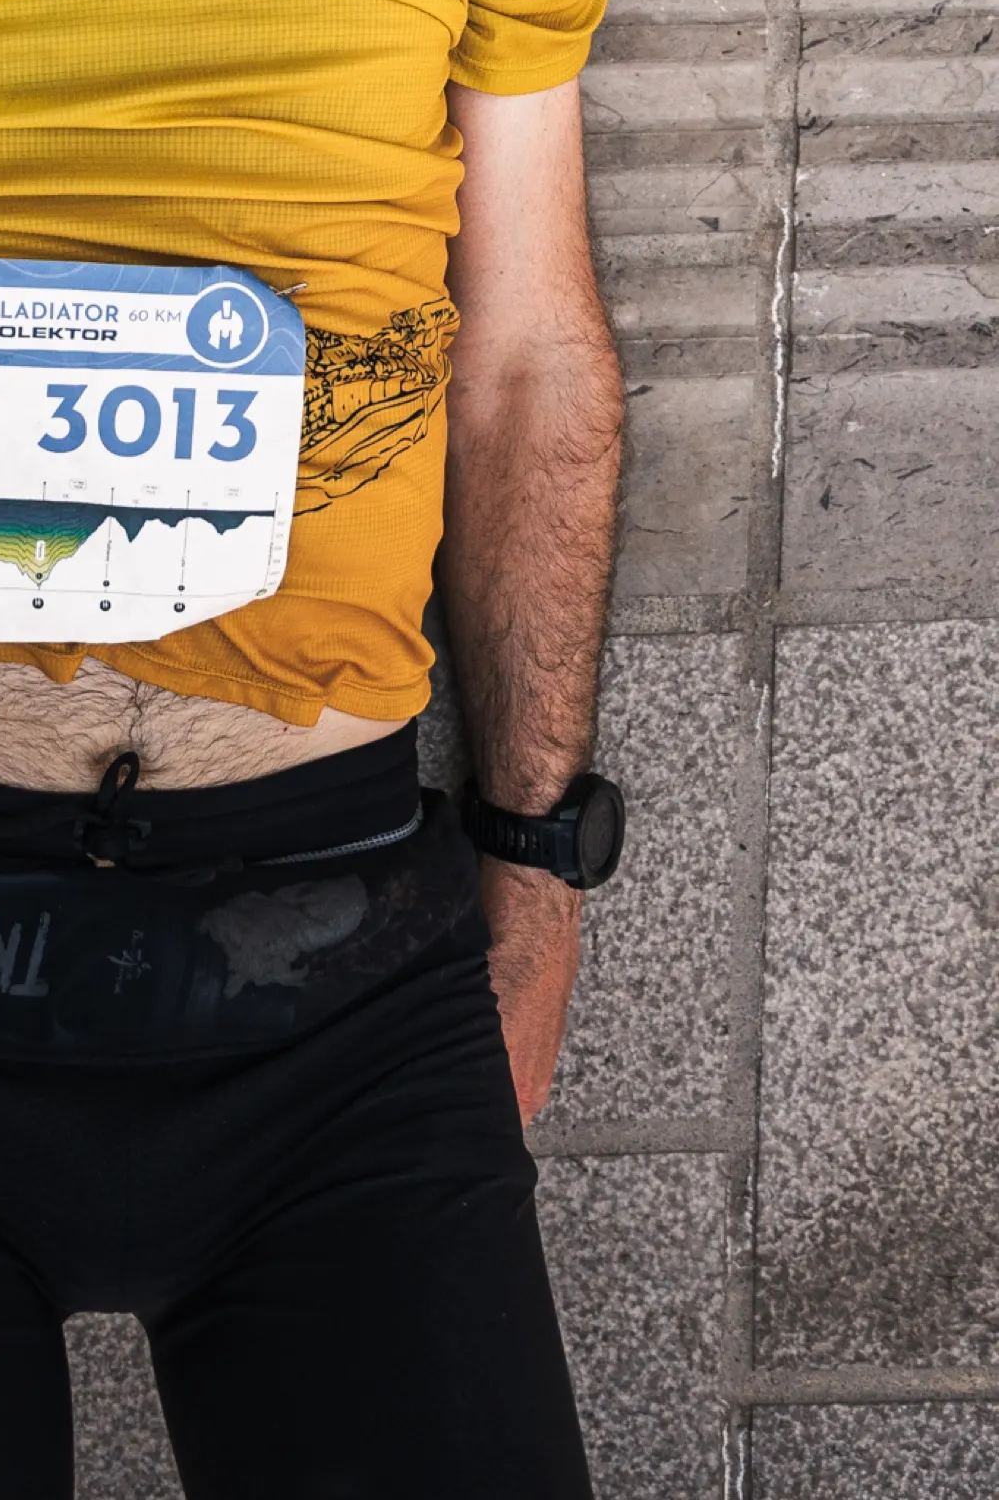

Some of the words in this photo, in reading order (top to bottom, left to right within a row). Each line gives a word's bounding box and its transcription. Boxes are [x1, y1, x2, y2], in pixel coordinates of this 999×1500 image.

[128, 309, 149, 322] 60
[155, 309, 183, 323] KM
[37, 383, 260, 462] 3013
